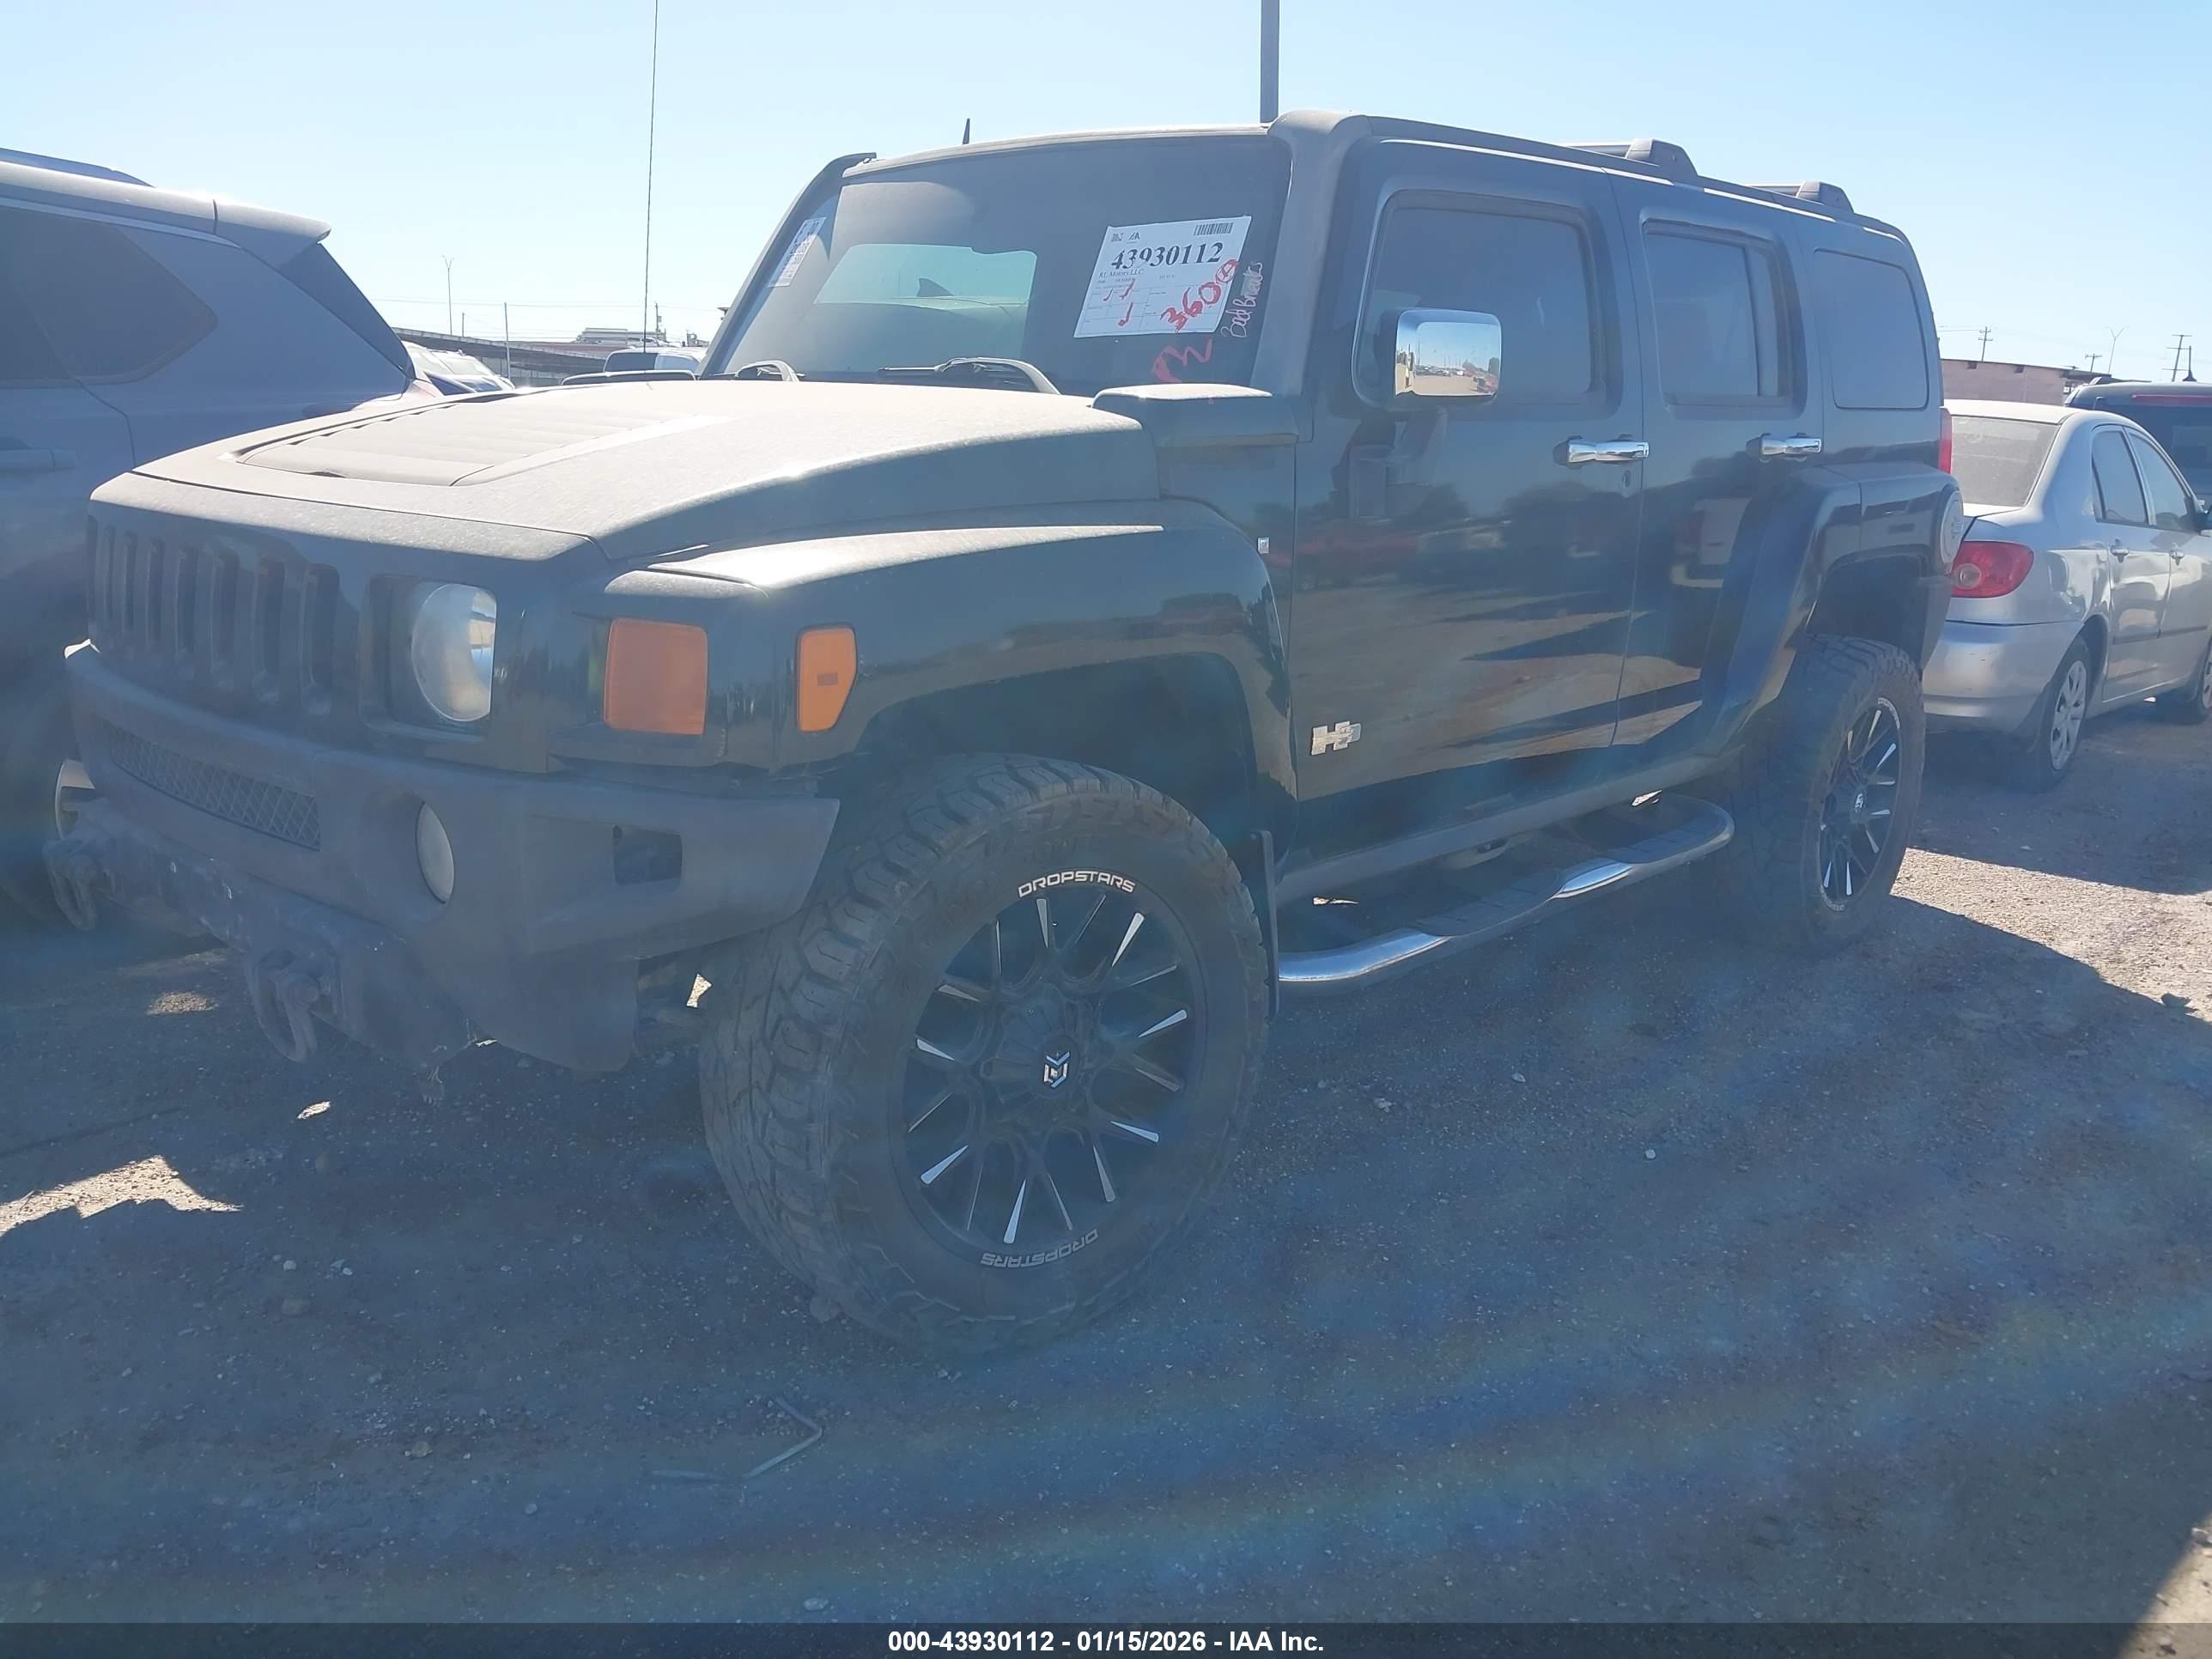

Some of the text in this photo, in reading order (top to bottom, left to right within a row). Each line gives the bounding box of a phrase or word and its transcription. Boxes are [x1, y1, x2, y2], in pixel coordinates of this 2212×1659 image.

[1111, 241, 1224, 270] 43930112
[1018, 869, 1136, 898] DROPSTARS
[980, 1228, 1099, 1269] DROPSTARS
